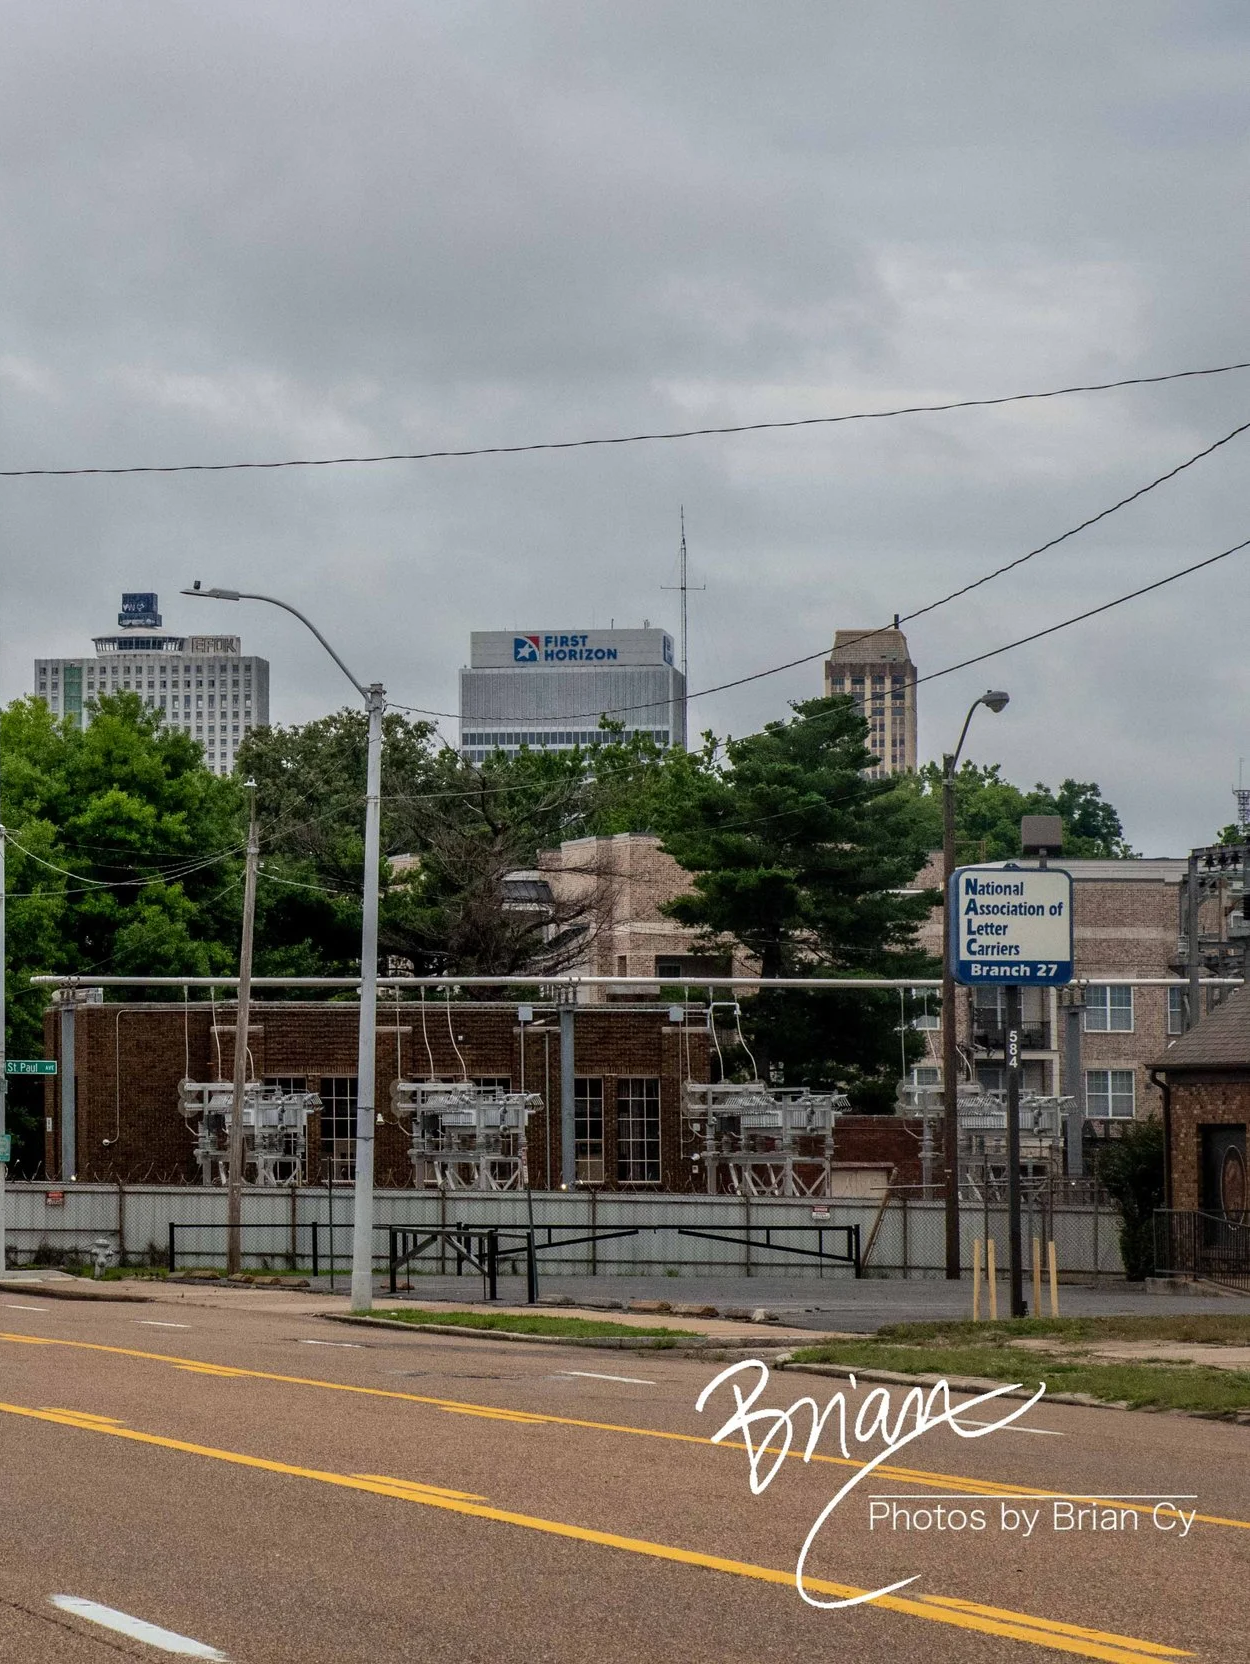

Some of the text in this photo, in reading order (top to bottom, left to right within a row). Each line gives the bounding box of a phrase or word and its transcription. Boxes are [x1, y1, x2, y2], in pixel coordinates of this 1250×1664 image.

[544, 635, 588, 648] FIRST
[544, 648, 618, 661] HORIZON
[964, 878, 1024, 896] National
[964, 898, 1063, 916] Association of
[966, 918, 1008, 936] Letter
[966, 938, 1020, 956] Carriers
[970, 963, 1058, 977] Branch 27
[7, 1062, 17, 1072] St
[20, 1062, 38, 1073] Paul
